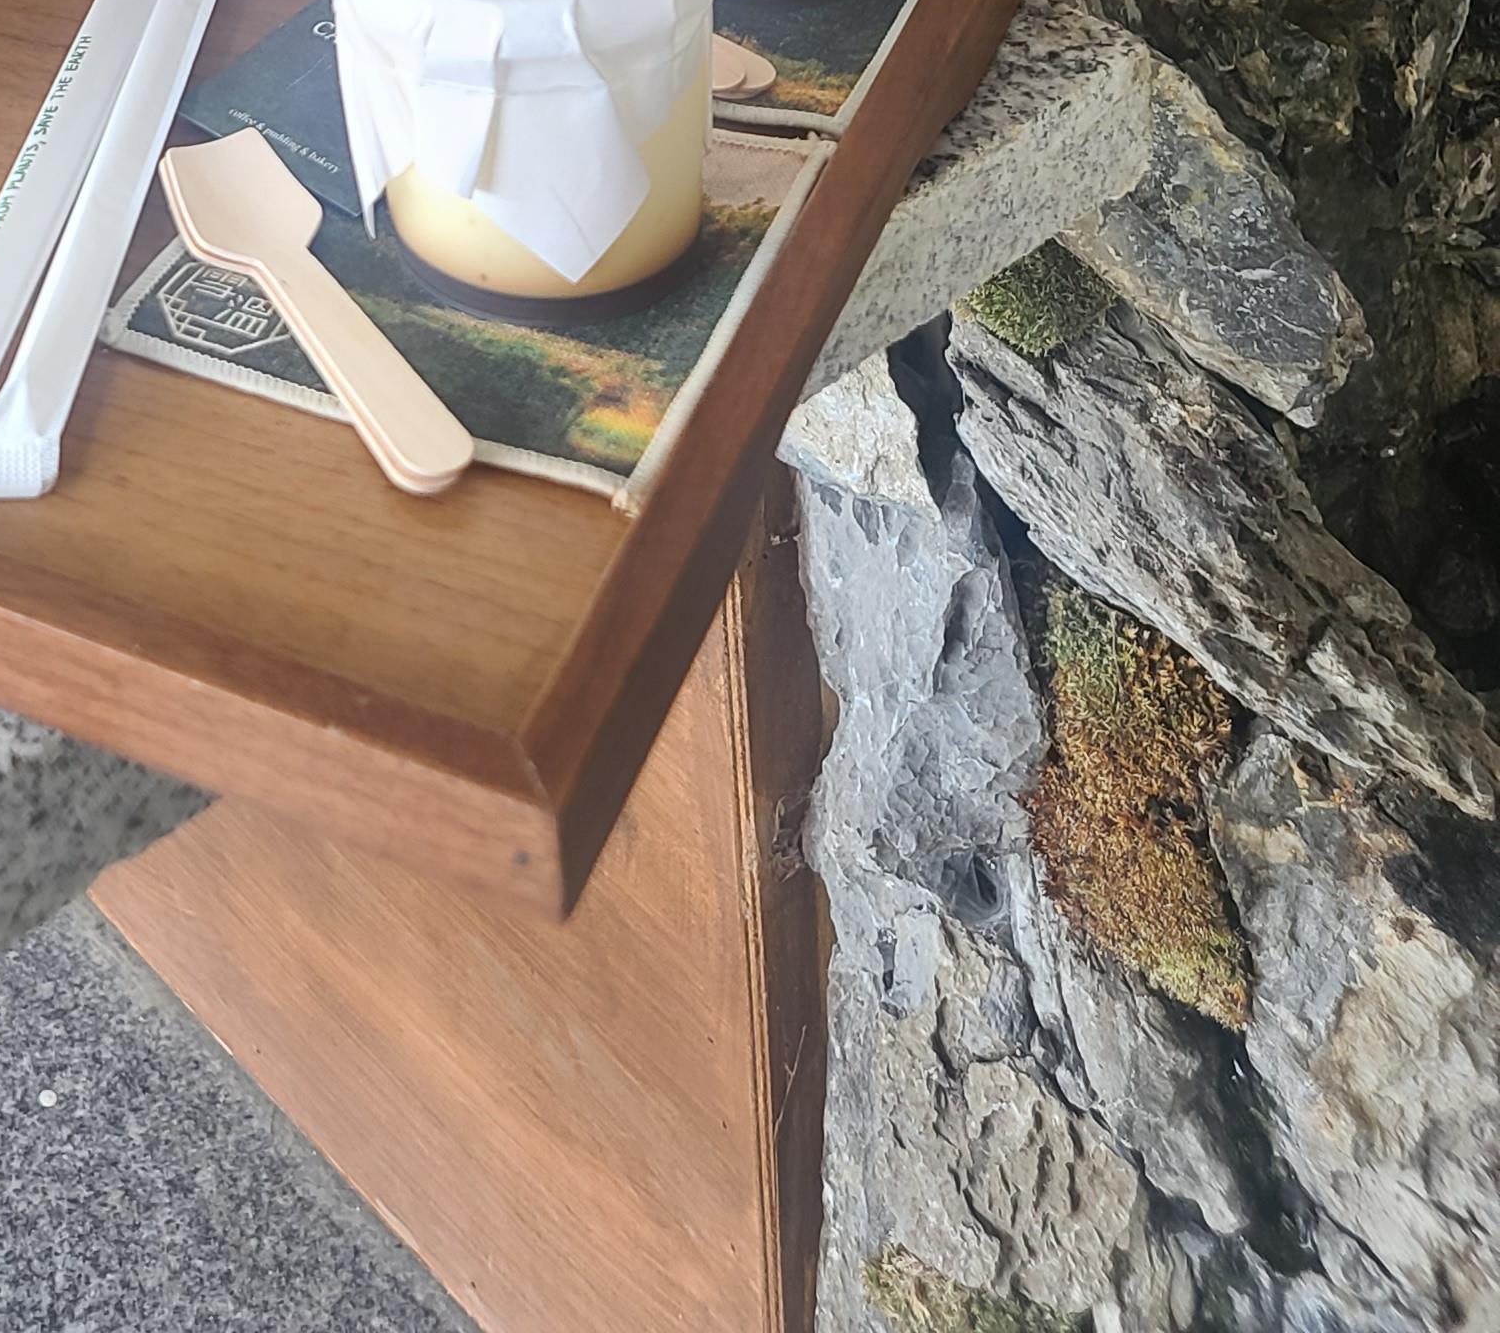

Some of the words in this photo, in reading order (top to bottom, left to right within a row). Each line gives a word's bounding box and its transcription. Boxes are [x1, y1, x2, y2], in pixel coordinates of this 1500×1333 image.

[33, 104, 59, 137] SAVE
[50, 76, 72, 101] THE
[65, 35, 92, 72] EARTH
[299, 146, 309, 156] &
